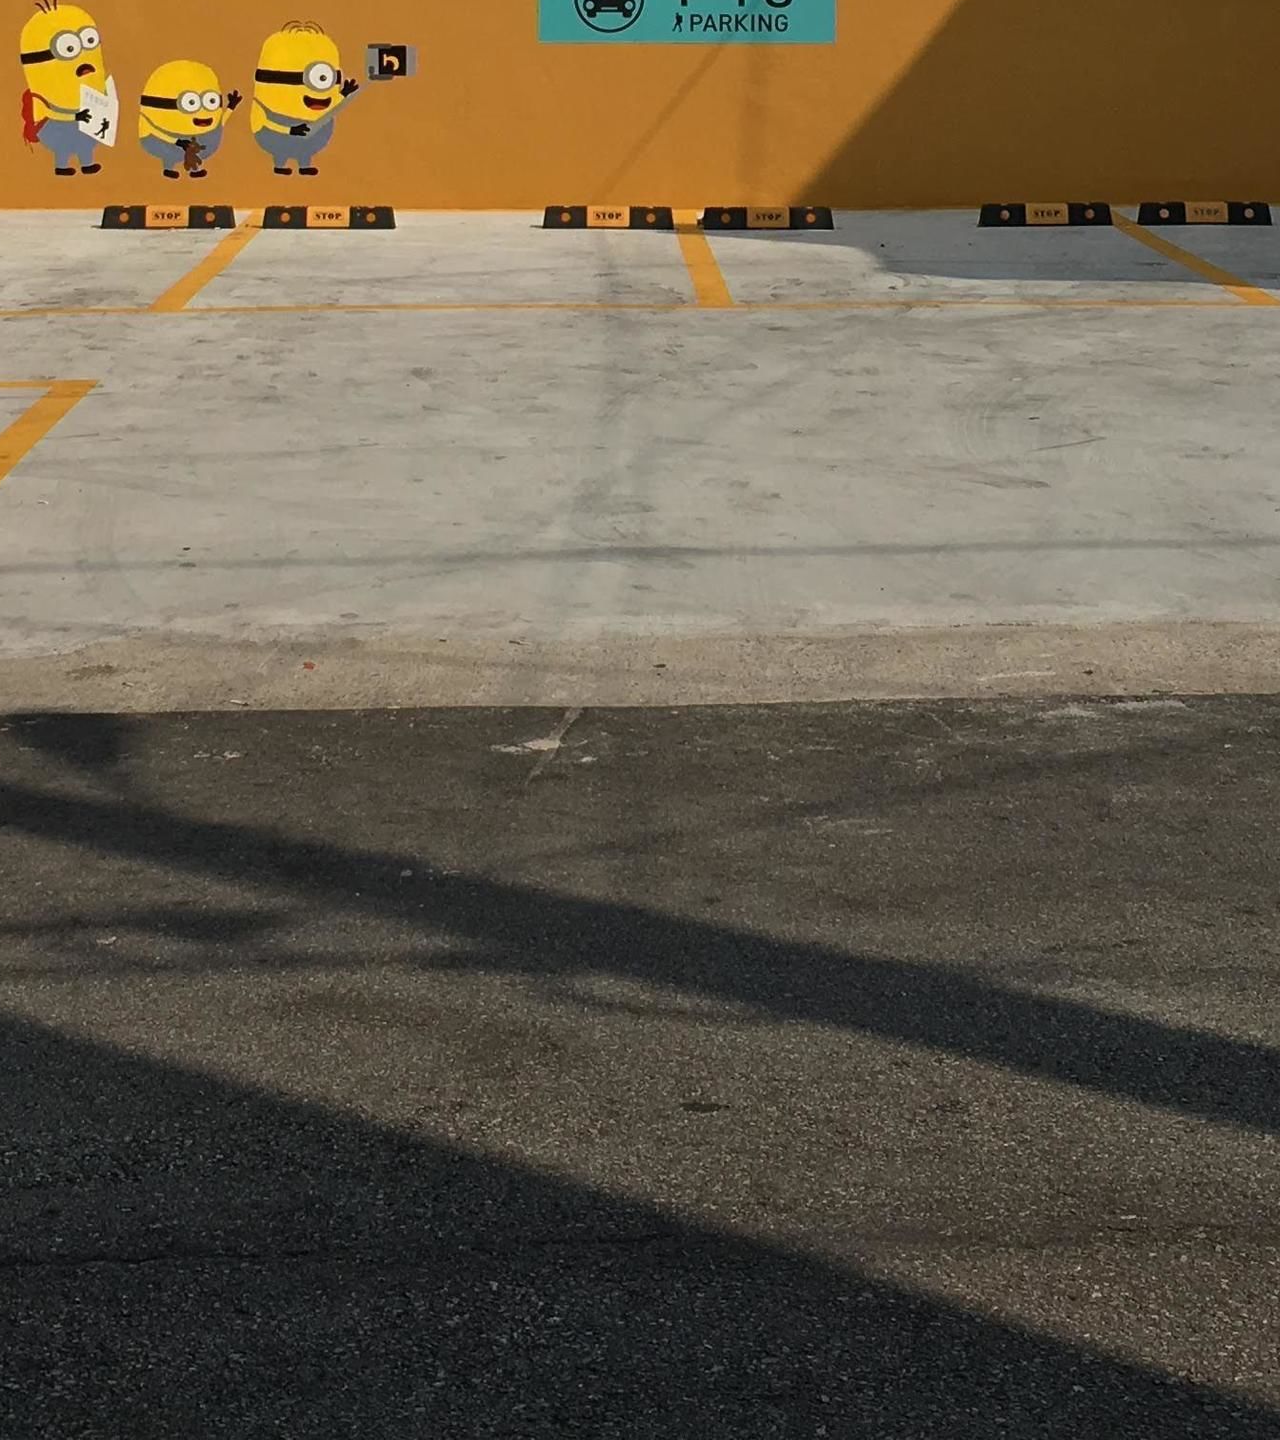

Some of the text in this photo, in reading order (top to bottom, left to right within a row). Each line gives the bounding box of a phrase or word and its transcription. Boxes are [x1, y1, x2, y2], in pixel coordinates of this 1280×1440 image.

[688, 13, 789, 33] PARKING
[153, 211, 182, 220] STOP
[595, 211, 623, 221] STOP
[1032, 209, 1062, 218] STOP
[1192, 207, 1220, 216] STOP
[314, 212, 343, 221] STOP
[754, 212, 782, 221] STOP
